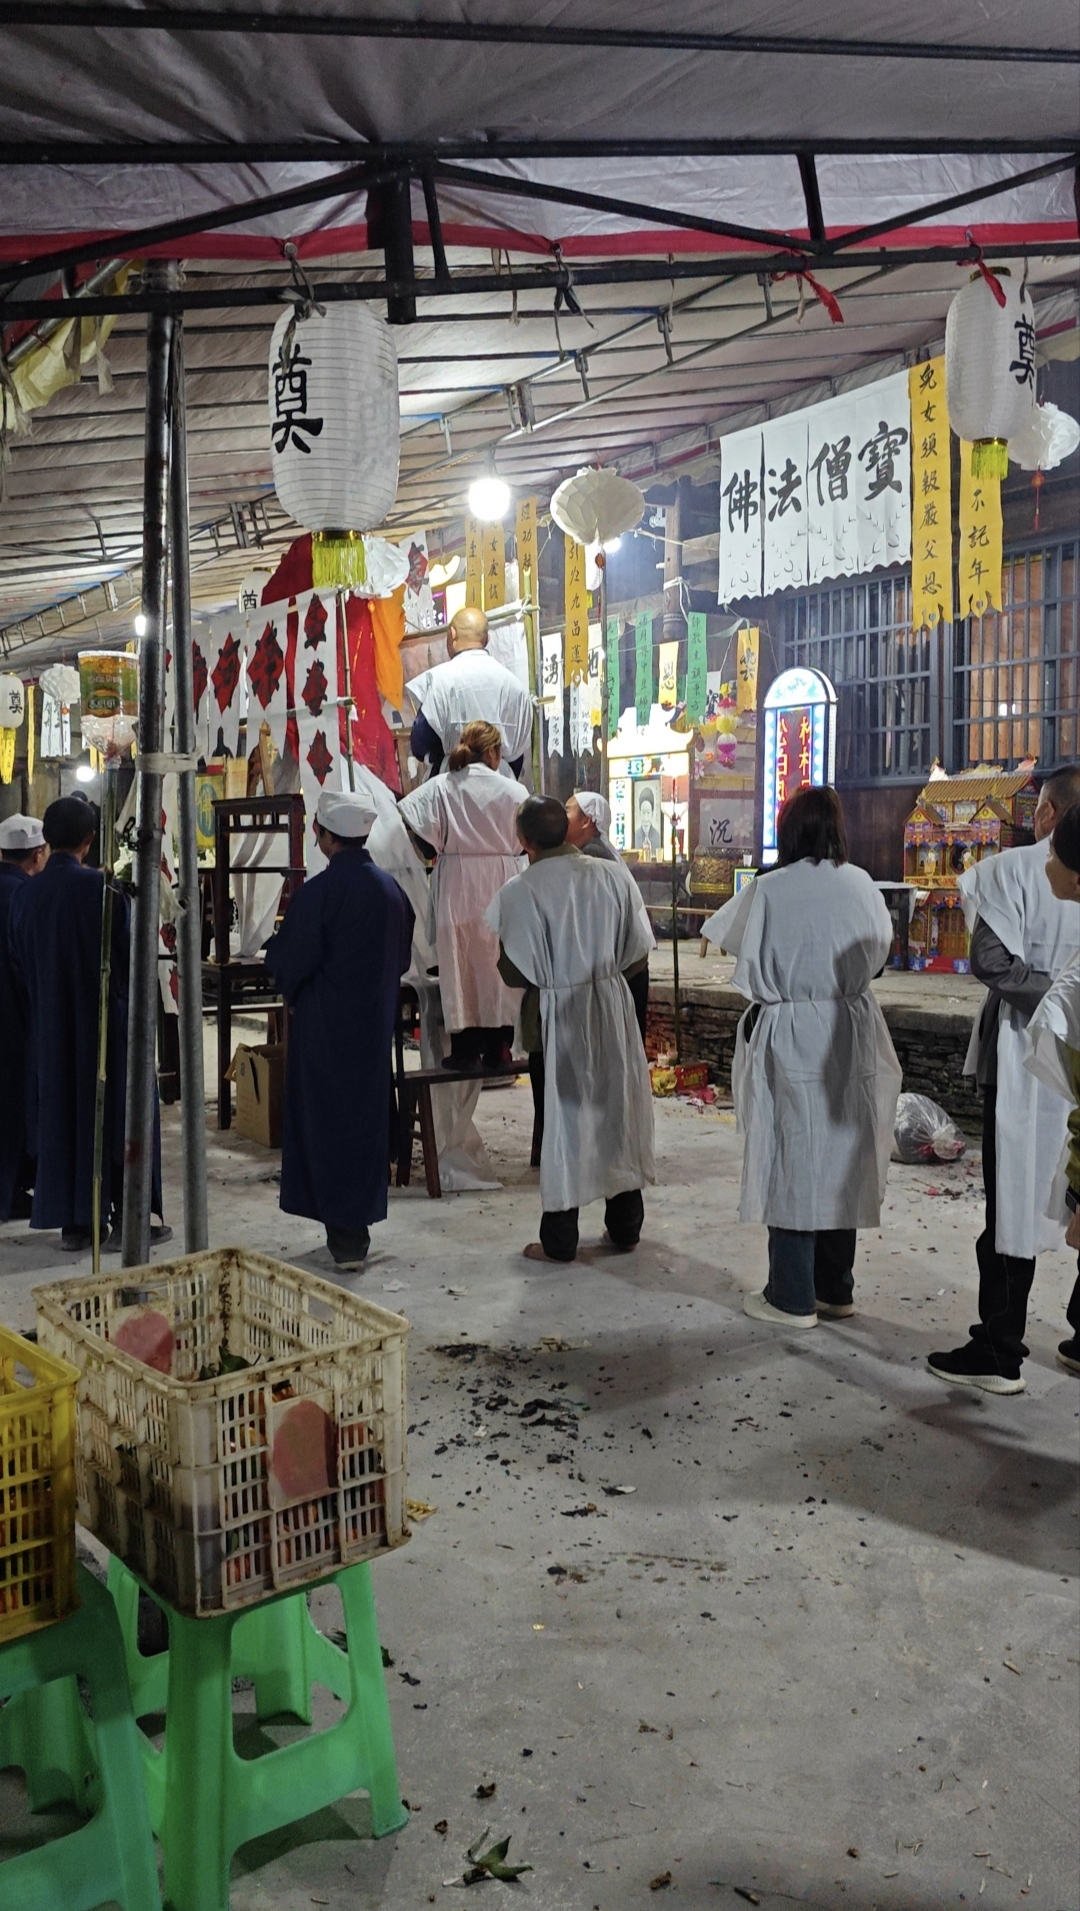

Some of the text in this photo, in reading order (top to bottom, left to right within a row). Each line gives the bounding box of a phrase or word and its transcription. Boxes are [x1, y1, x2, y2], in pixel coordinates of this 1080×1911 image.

[272, 343, 324, 454] 奠
[721, 420, 909, 534] 佛法僧寶
[967, 488, 991, 586] 不記年
[9, 689, 23, 714] 奠
